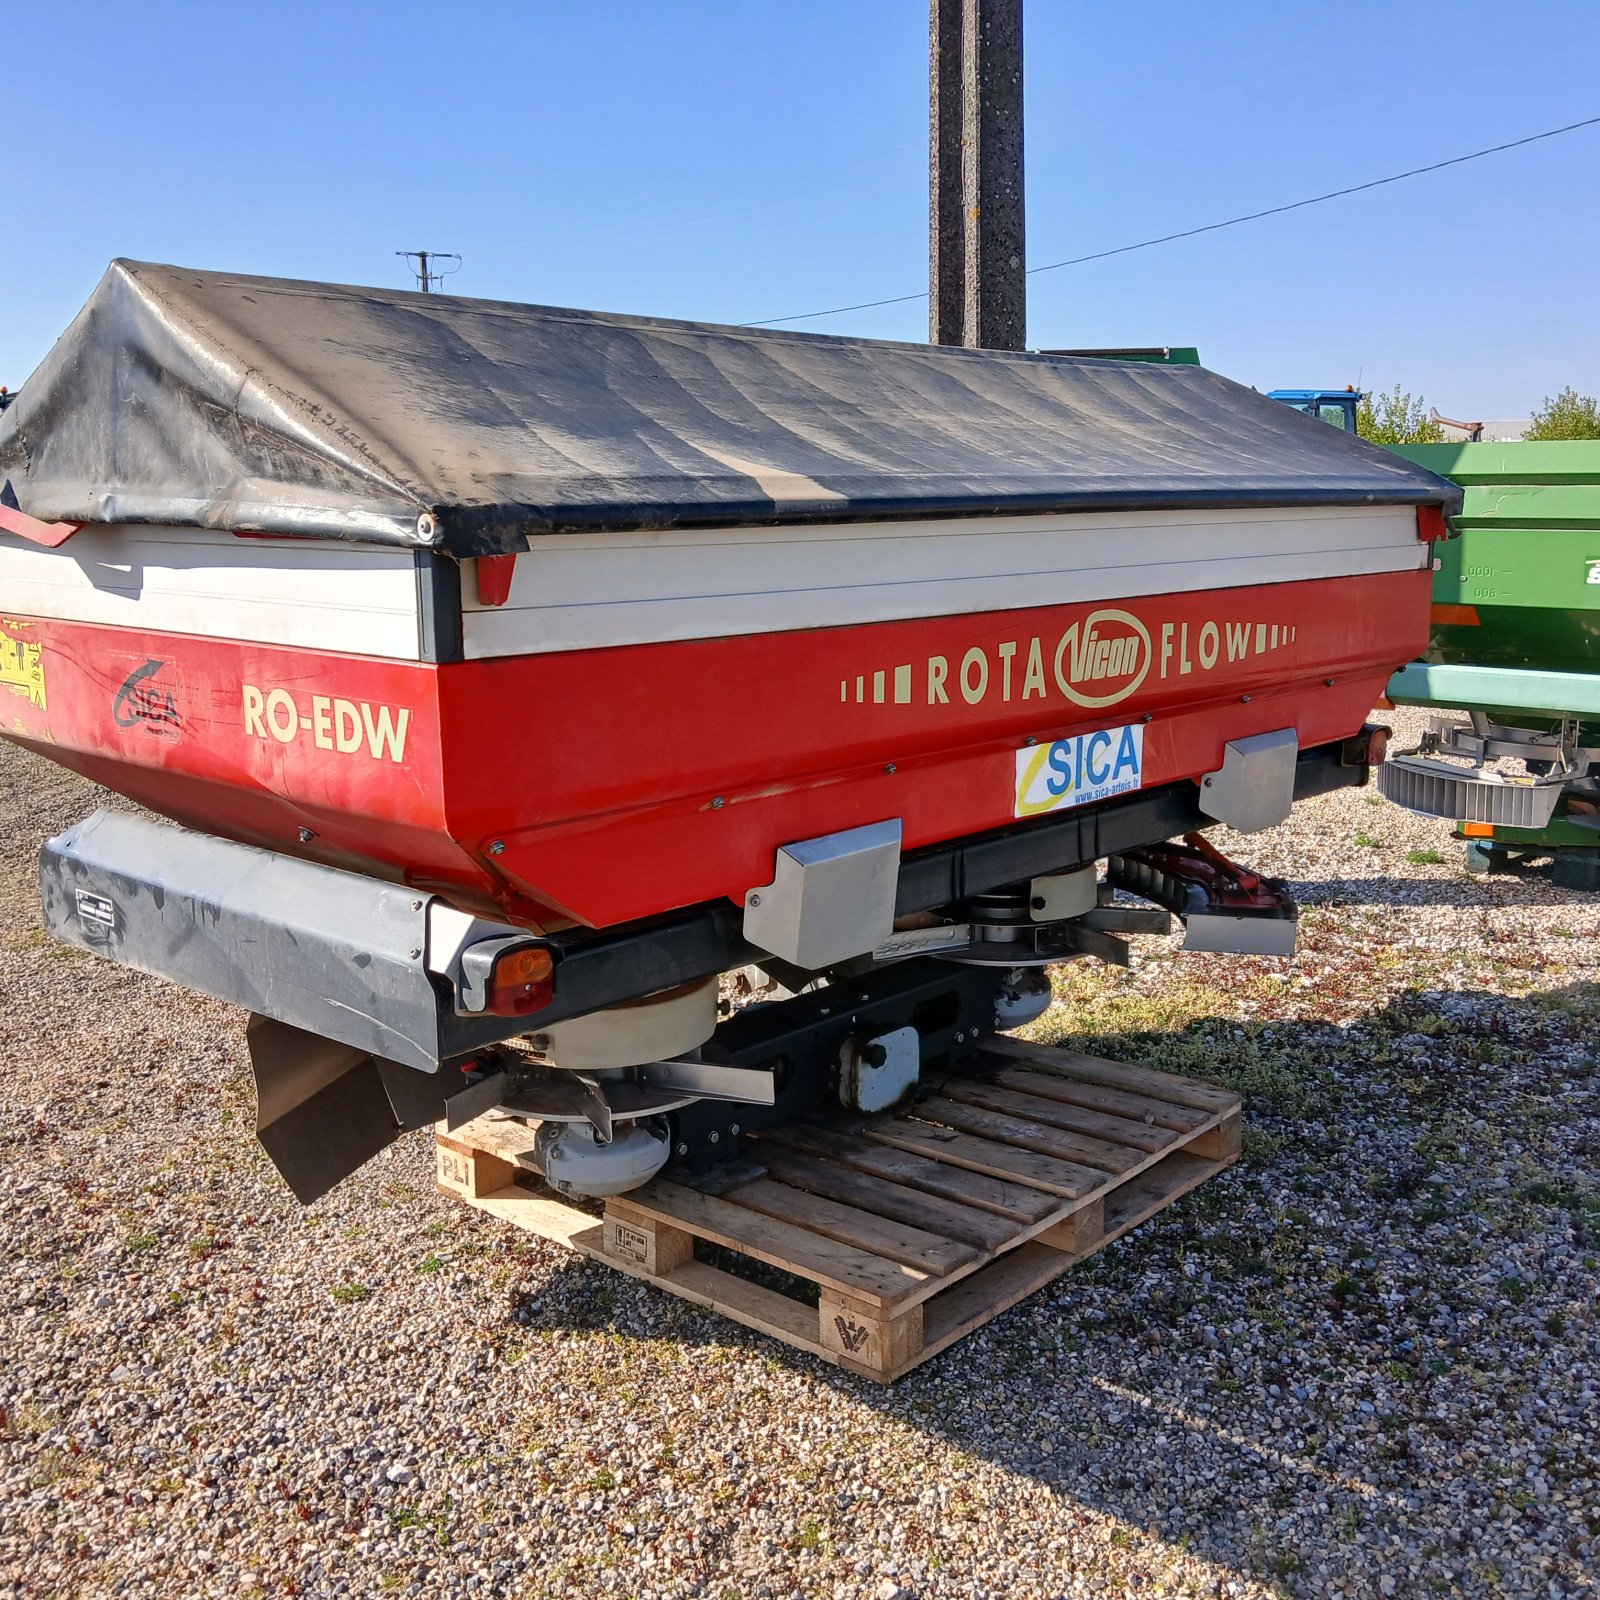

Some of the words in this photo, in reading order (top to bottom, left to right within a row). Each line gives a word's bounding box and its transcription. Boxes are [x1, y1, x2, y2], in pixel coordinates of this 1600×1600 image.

[928, 637, 1047, 705] ROTA
[1066, 616, 1140, 684] Vicon
[1160, 621, 1252, 680] FLOW
[127, 687, 181, 723] SICA
[242, 684, 410, 764] RO-EDW
[1046, 724, 1140, 796] SICA
[1074, 777, 1139, 804] www.sica-artois.fr
